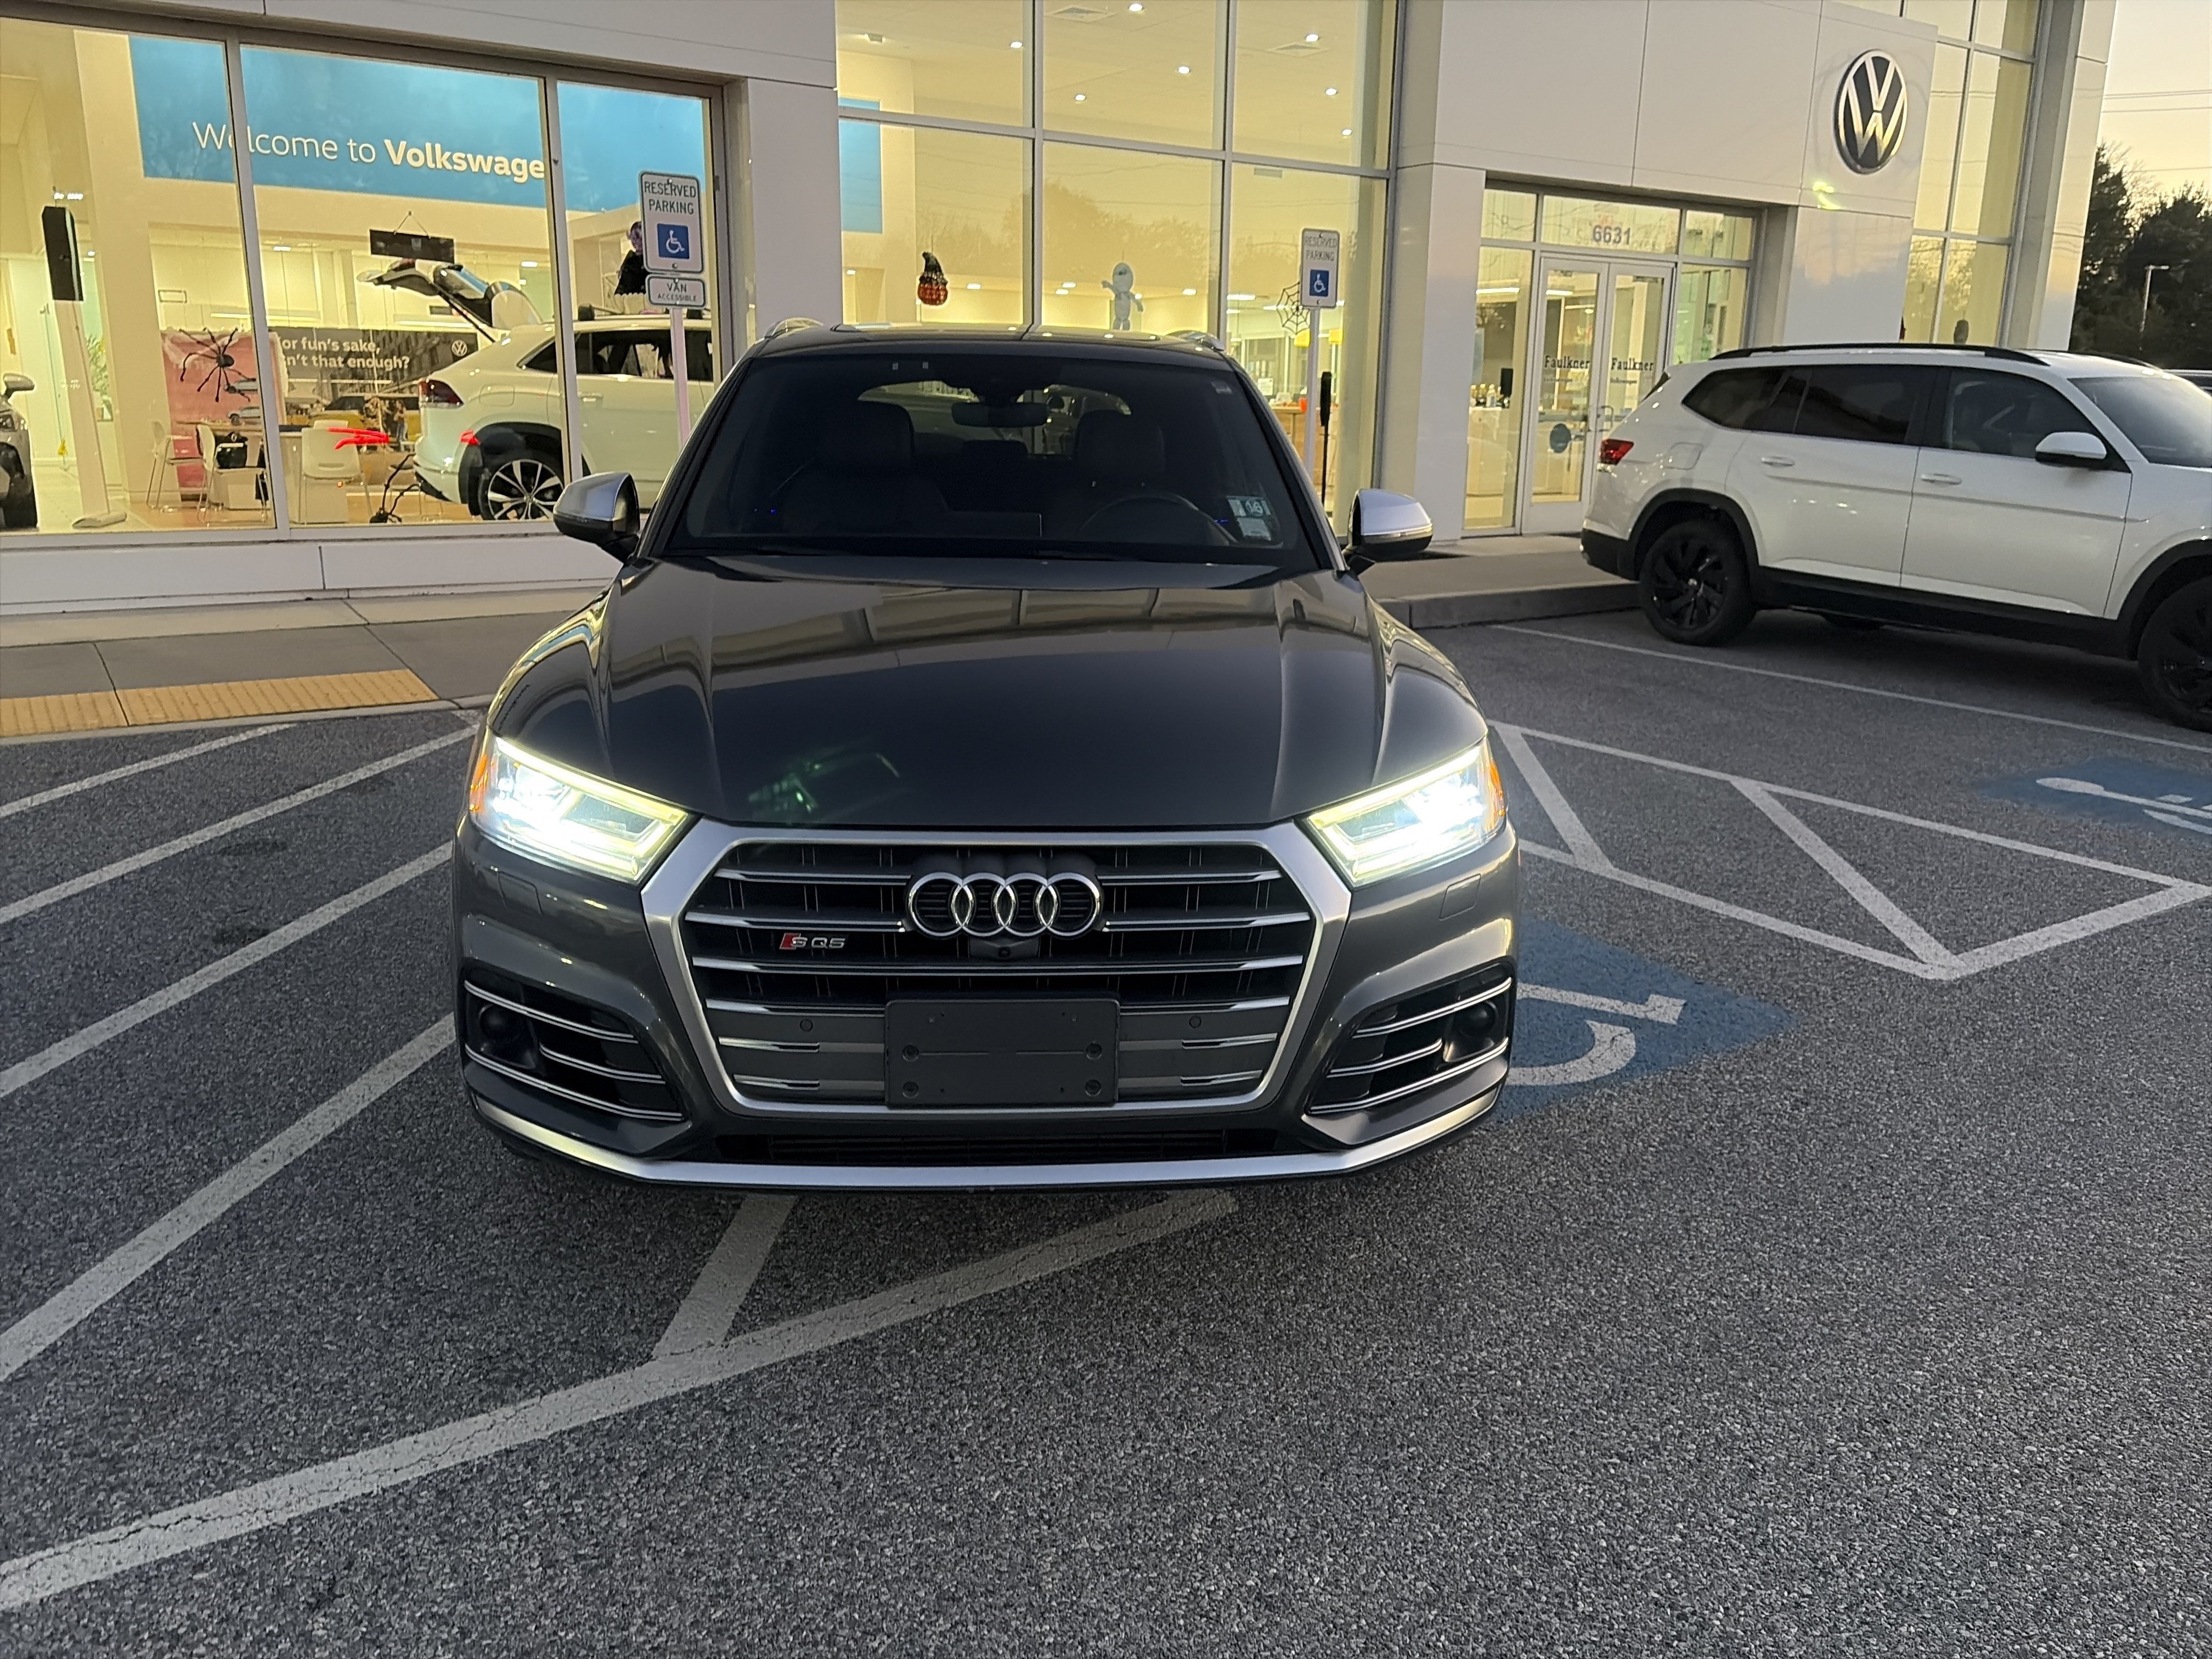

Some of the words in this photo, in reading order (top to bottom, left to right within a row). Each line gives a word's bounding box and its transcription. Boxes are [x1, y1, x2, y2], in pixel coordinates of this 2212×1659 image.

[347, 139, 376, 163] to
[383, 139, 545, 184] Volkswage
[644, 181, 696, 198] RESERVED
[648, 199, 695, 215] PARKING
[1305, 235, 1338, 249] RESERVED
[1593, 225, 1632, 245] 6631
[1306, 250, 1335, 262] PARKING
[667, 283, 687, 293] VAN
[657, 294, 697, 302] ACCESSIBLE
[279, 336, 298, 349] or
[301, 337, 340, 352] fun's
[343, 338, 381, 354] sake,
[312, 354, 345, 368] that
[347, 356, 410, 371] enough?
[1544, 355, 1590, 369] Faulkner
[1611, 357, 1655, 371] Faulkner
[791, 936, 845, 949] SQ5
